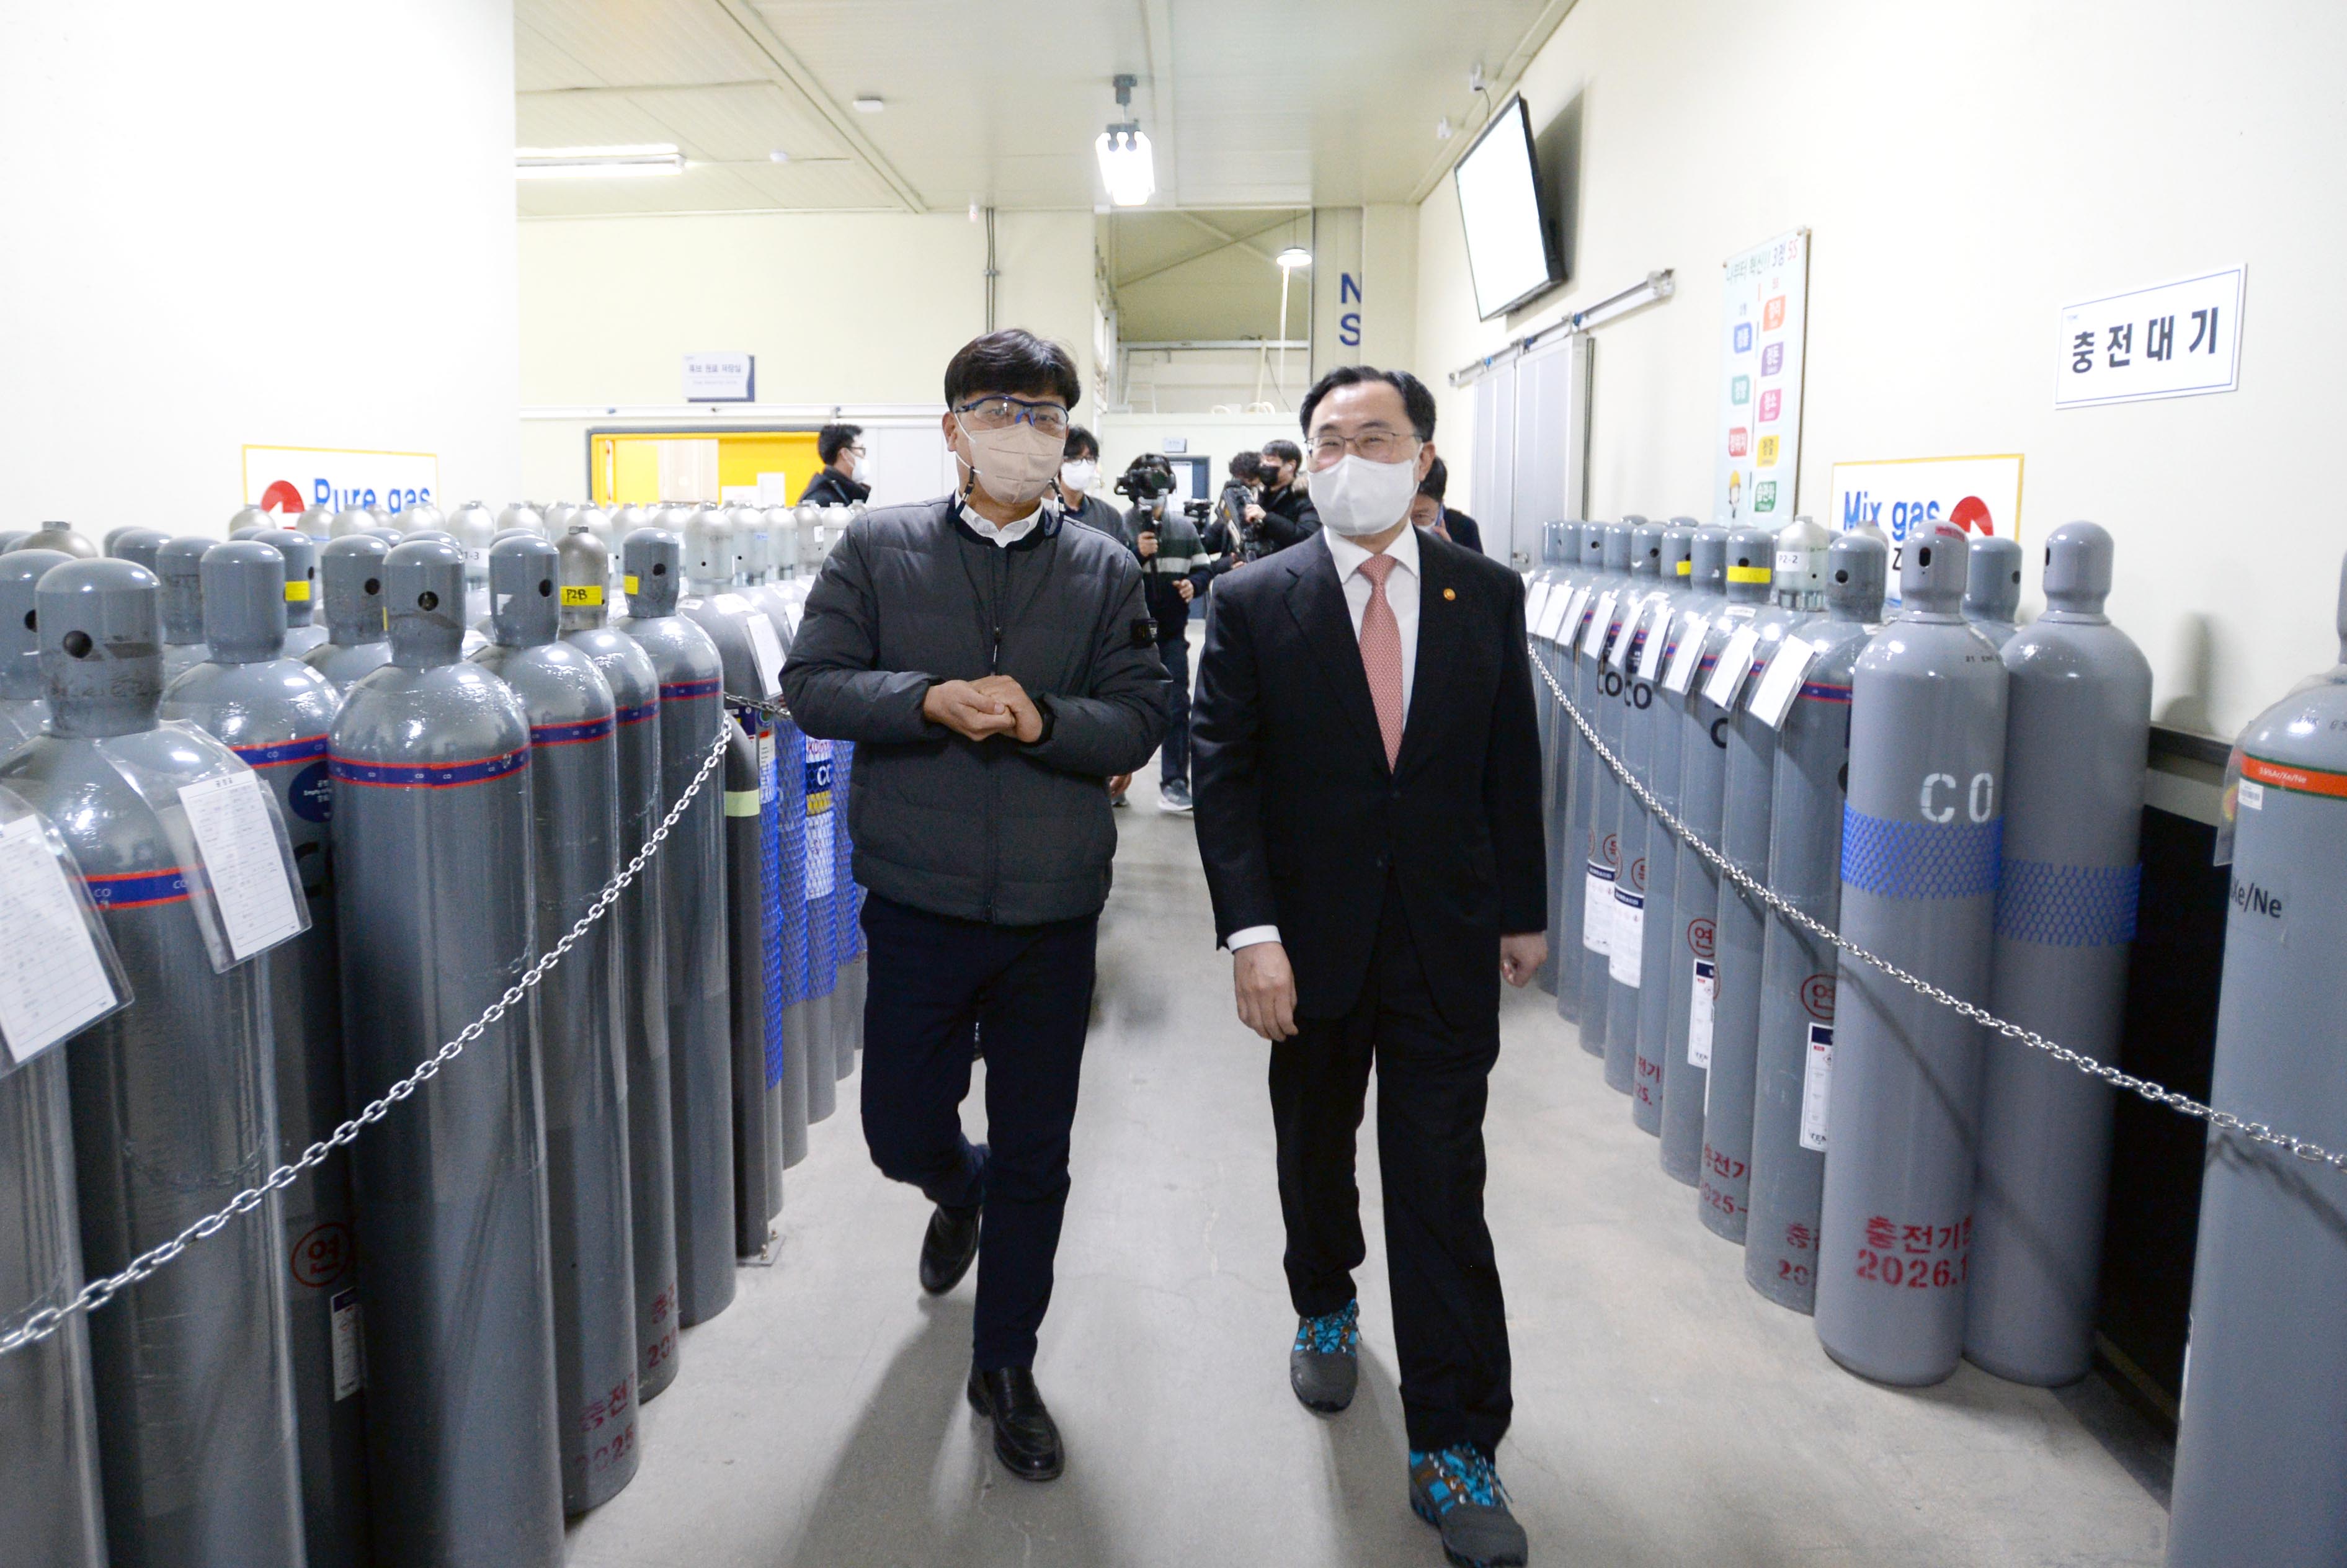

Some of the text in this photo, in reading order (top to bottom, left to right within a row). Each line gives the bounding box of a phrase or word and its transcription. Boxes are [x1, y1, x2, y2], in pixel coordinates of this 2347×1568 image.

[2072, 306, 2219, 373] 충전대기
[314, 478, 376, 514] Pure
[1843, 491, 1882, 531] Mix
[1892, 501, 1940, 541] gas
[461, 551, 479, 560] 1-3
[1921, 772, 1994, 824] CO
[94, 888, 112, 898] CO
